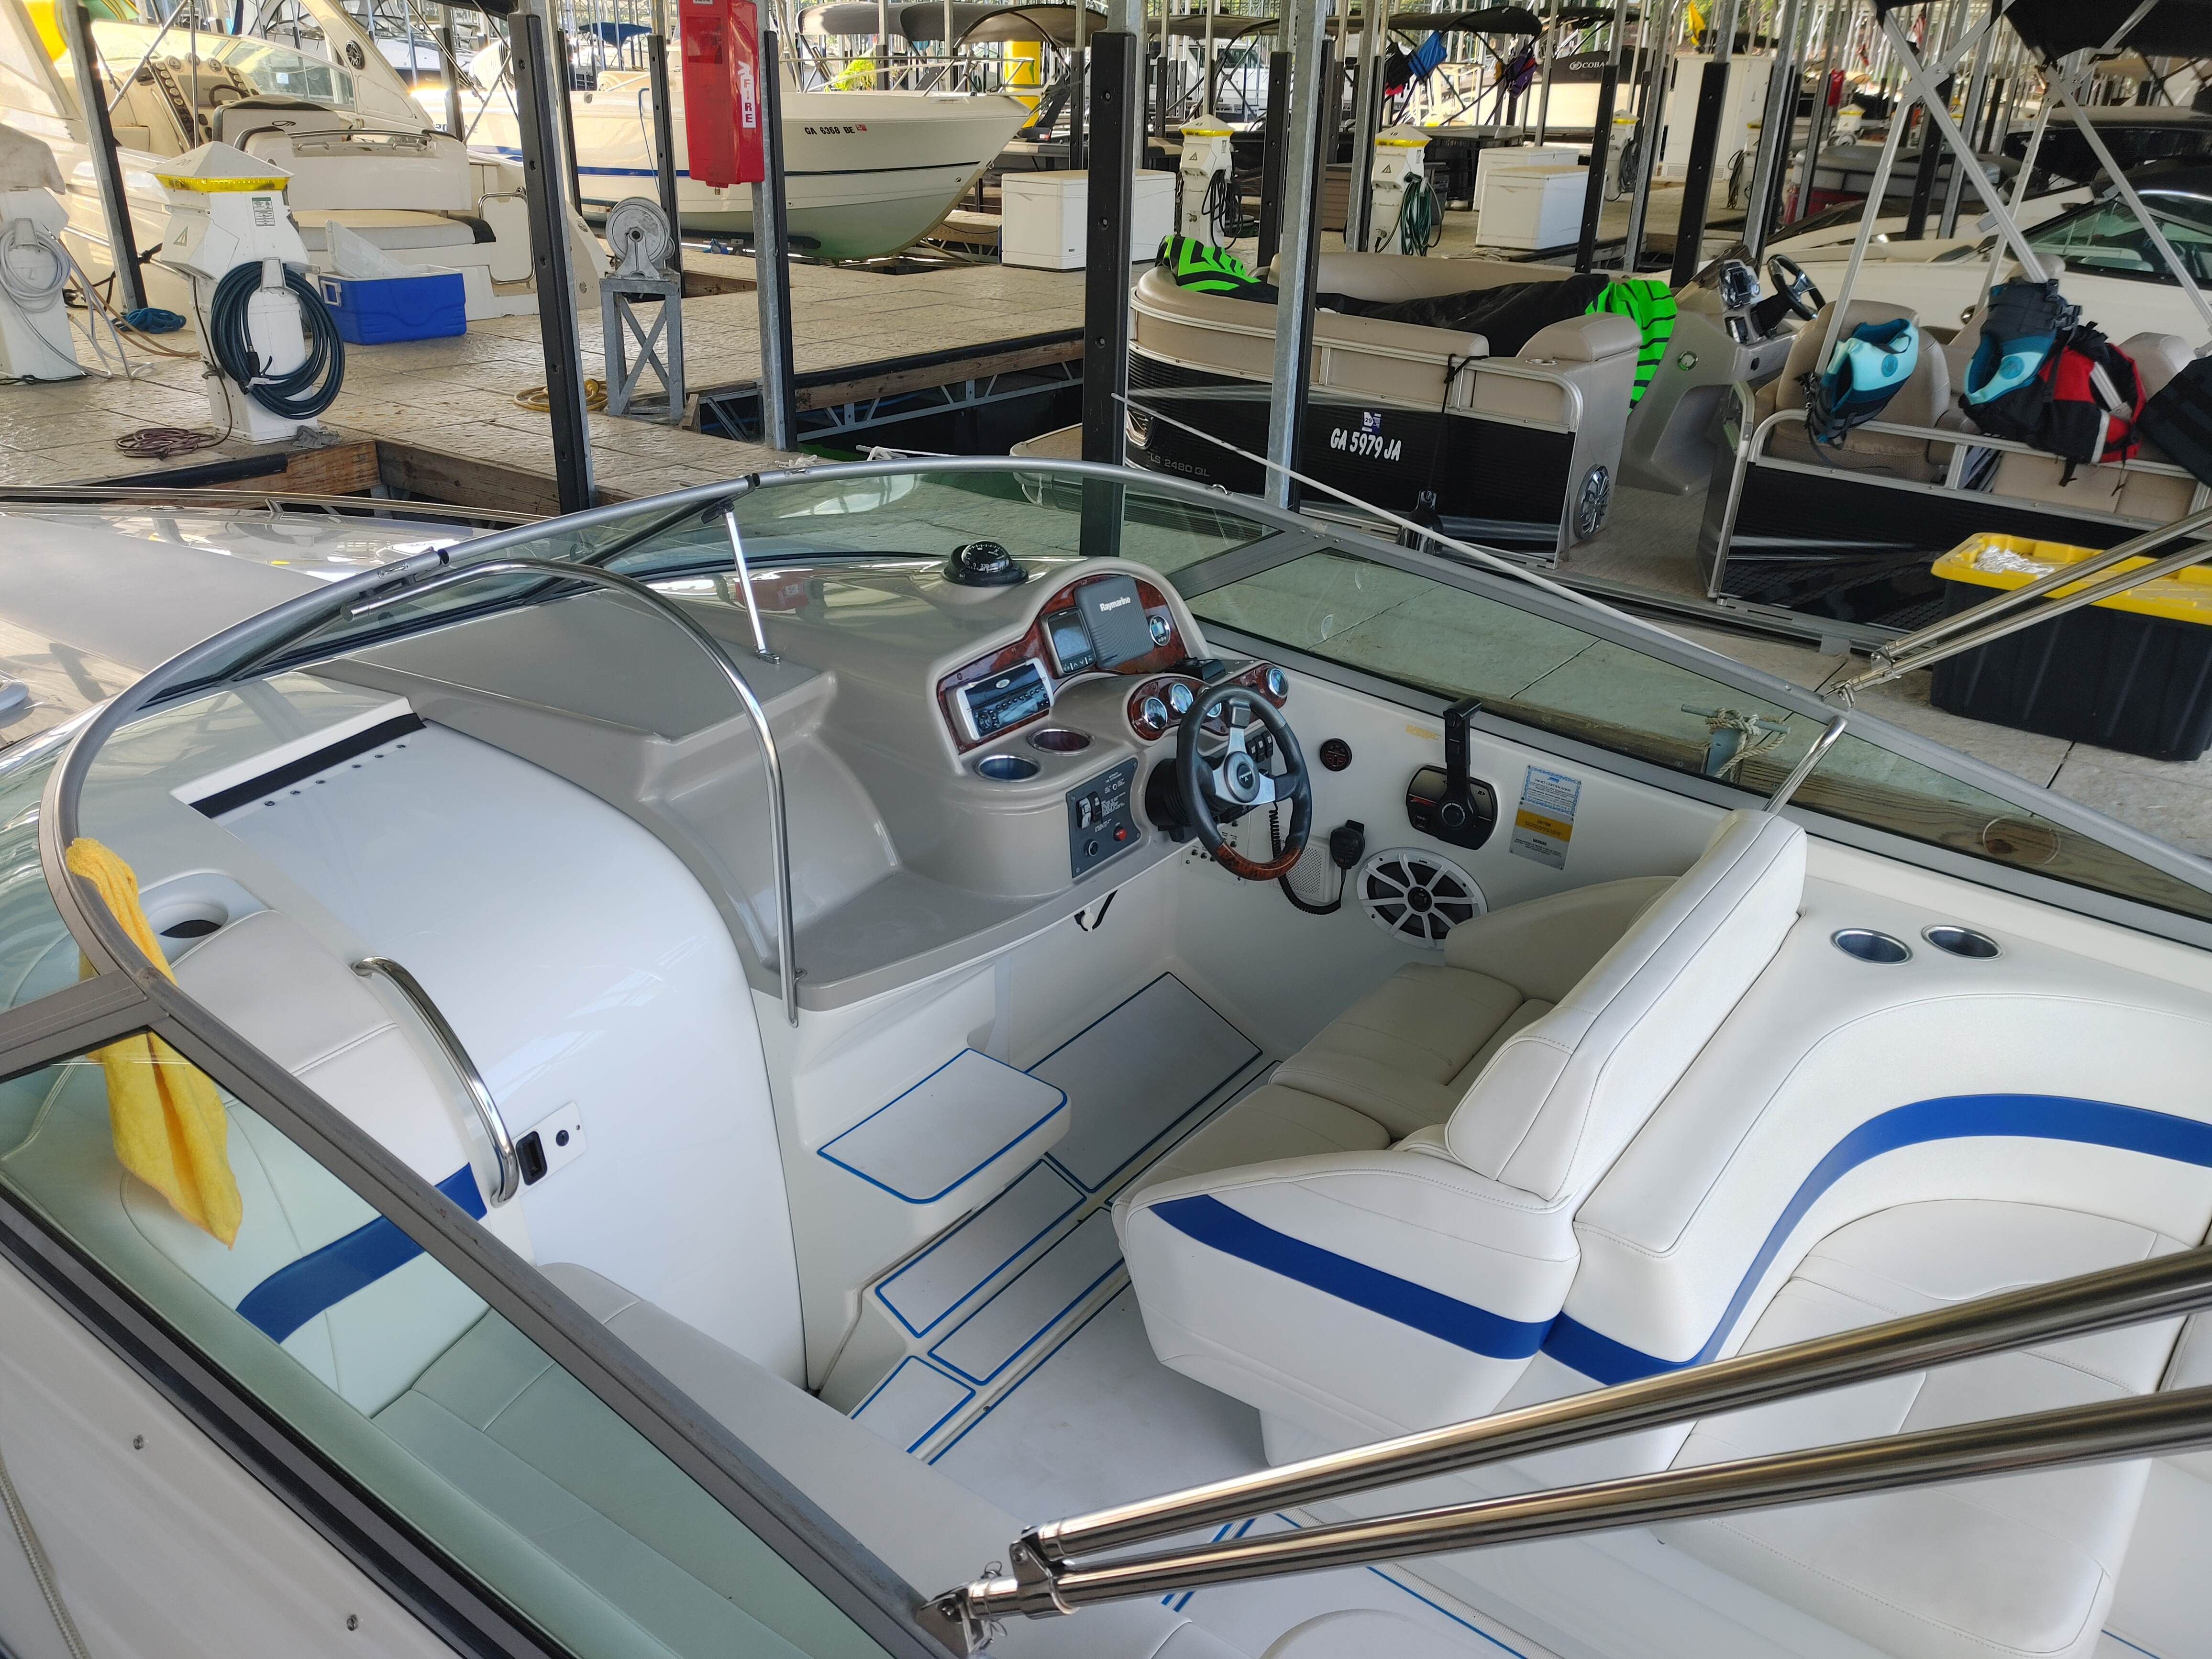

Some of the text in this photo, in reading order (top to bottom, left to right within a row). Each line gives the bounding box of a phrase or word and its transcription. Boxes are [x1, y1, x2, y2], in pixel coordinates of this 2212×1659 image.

[743, 79, 753, 123] FIRE
[819, 126, 841, 134] 6368
[1330, 428, 1402, 462] GA 5979 JA
[1164, 459, 1193, 473] 2480
[1099, 597, 1131, 612] Raymarine
